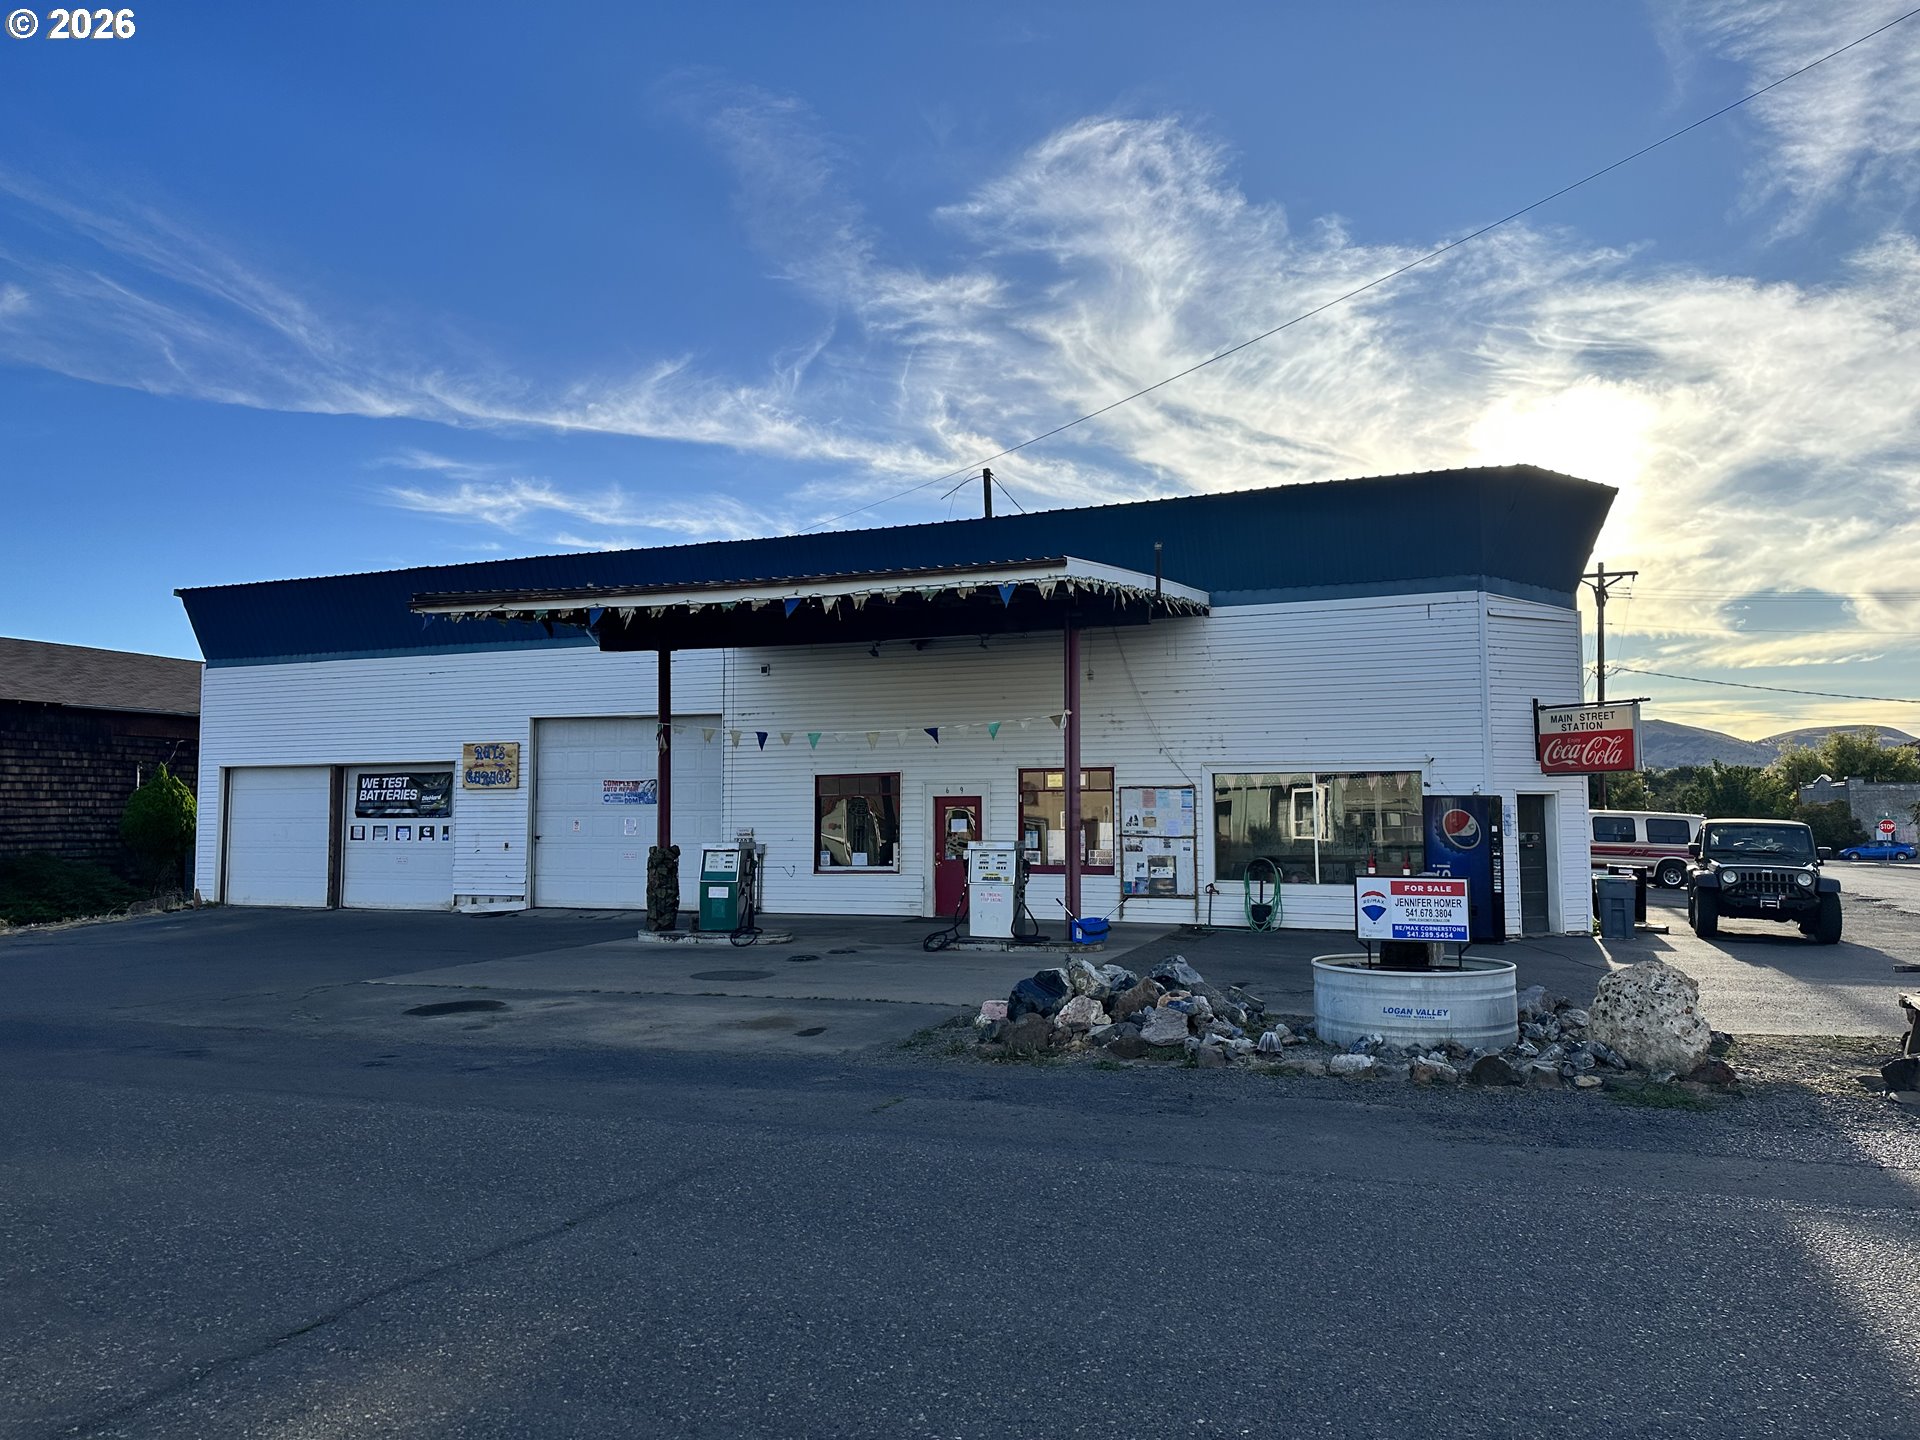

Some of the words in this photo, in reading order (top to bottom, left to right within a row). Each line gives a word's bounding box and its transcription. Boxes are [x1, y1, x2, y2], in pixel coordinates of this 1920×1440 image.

[1550, 714, 1573, 723] MAIN
[1579, 711, 1615, 721] STREET
[1561, 721, 1603, 732] STATION
[1543, 735, 1625, 767] Coca-Cola
[361, 777, 380, 789] WE
[381, 776, 410, 789] TEST
[359, 788, 418, 801] BATTERIES
[1427, 885, 1452, 893] SALE
[1394, 897, 1432, 908] JENNIFER
[1433, 898, 1462, 909] HOMER
[1405, 908, 1452, 918] 541.678.3804
[1420, 925, 1465, 933] CORNERSTONE
[1406, 931, 1454, 939] 541.289.5454
[1382, 1006, 1414, 1015] LOGAN
[1415, 1008, 1449, 1016] VALLEY
